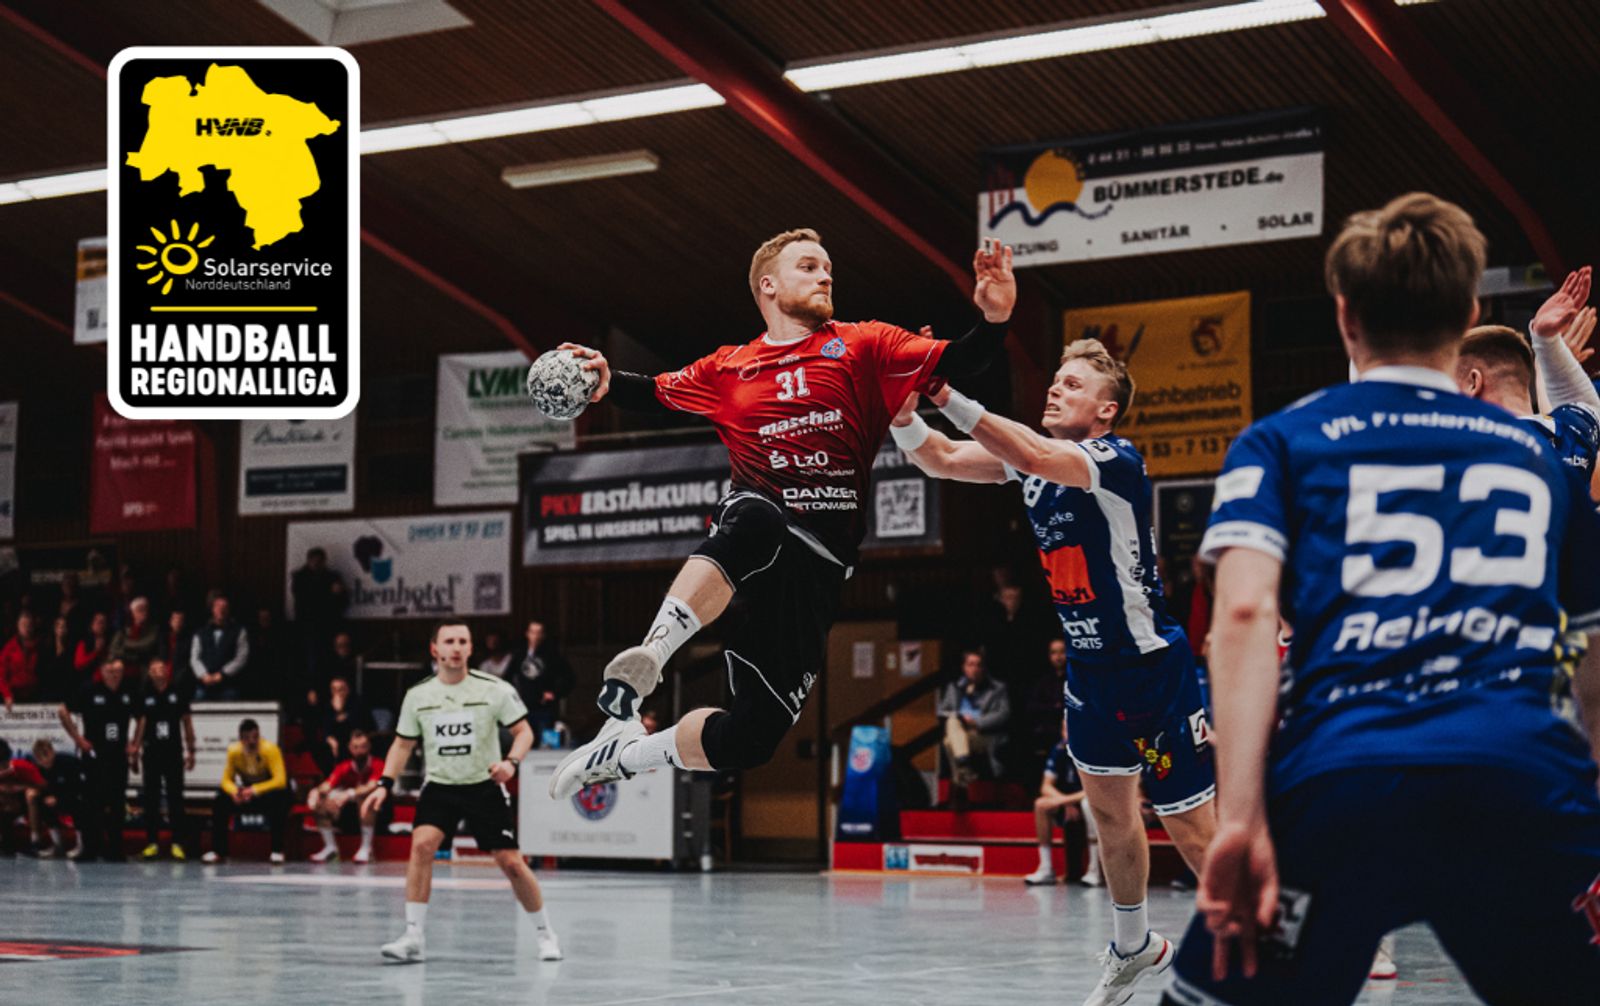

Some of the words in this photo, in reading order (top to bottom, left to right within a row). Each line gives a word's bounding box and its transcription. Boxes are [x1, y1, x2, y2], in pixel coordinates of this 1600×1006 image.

[1092, 166, 1285, 204] BÜMMERSTEDE.de
[1120, 225, 1191, 245] SANITÄR
[1257, 212, 1315, 231] SOLAR
[775, 366, 811, 401] 31
[1133, 380, 1242, 407] achbetrieb
[758, 408, 843, 436] maschal
[540, 480, 718, 519] PKVERSTÄRKUNG
[782, 486, 858, 500] DANZER
[543, 524, 577, 544] SPIEL
[578, 523, 593, 539] IN
[594, 516, 660, 538] UNSEREM
[1341, 463, 1553, 599] 53
[1071, 636, 1104, 650] ORTS
[435, 722, 472, 737] KUS
